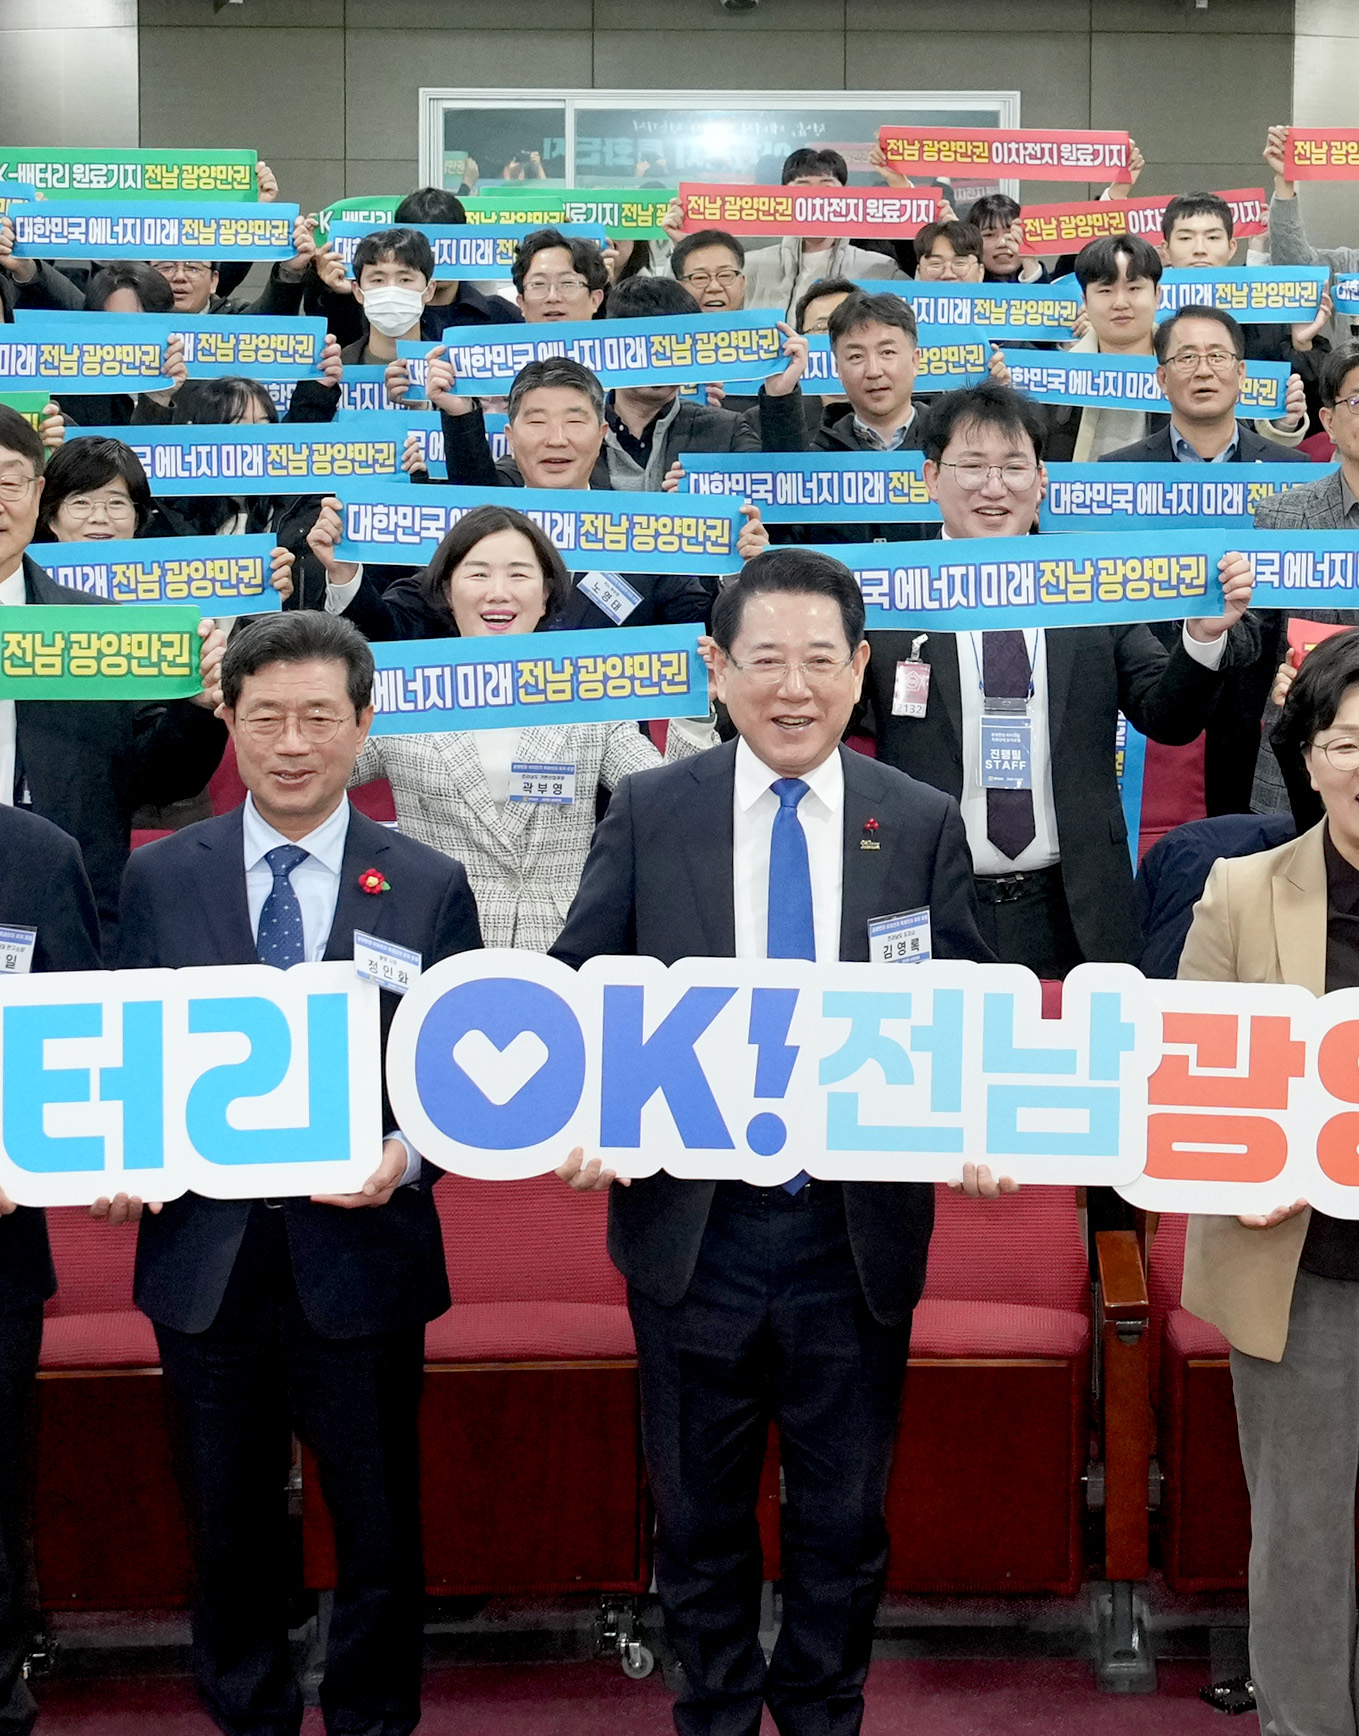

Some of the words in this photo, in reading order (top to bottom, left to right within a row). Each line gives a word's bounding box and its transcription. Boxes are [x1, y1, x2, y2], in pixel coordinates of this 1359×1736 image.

[887, 138, 920, 161] 전남
[922, 139, 990, 164] 광양만권
[991, 142, 1058, 165] 이차전지
[1060, 143, 1128, 168] 원료기지
[1293, 140, 1328, 165] 전남
[72, 163, 142, 190] 원료기지
[144, 163, 179, 190] 전남
[181, 165, 251, 191] 광양만권
[621, 203, 653, 228] 전남
[688, 194, 723, 221] 전남
[724, 194, 793, 222] 광양만권
[795, 198, 864, 223] 이차전지
[15, 216, 87, 245] 대한민국
[219, 218, 289, 246] 광양만권
[1060, 211, 1126, 241] 광양만권
[459, 238, 494, 266] 미래
[1178, 282, 1213, 310] 미래
[1251, 281, 1318, 308] 광양만권
[938, 297, 972, 325] 미래
[81, 345, 161, 377] 광양만권
[237, 333, 316, 364] 광양만권
[604, 336, 648, 370] 미래
[694, 327, 780, 362] 광양만권
[1067, 368, 1122, 398] 에너지
[154, 445, 218, 478] 에너지
[311, 440, 397, 476] 광양만권
[843, 471, 885, 505] 미래
[1050, 481, 1136, 515] 대한민국
[1203, 482, 1244, 516] 미래
[347, 502, 447, 544] 대한민국
[579, 510, 630, 553] 전남
[631, 513, 731, 555] 광양만권
[112, 561, 162, 601] 전남
[165, 556, 264, 599] 광양만권
[894, 563, 977, 612] 에너지
[1039, 558, 1095, 603] 전남
[1097, 554, 1208, 601] 광양만권
[1284, 550, 1354, 589] 에너지
[3, 630, 65, 678] 전남
[70, 631, 190, 678] 광양만권
[372, 666, 452, 715] 에너지
[456, 661, 513, 708] 미래
[516, 656, 574, 705] 전남
[576, 649, 691, 700] 광양만권
[895, 702, 923, 715] 2132
[984, 759, 1027, 771] STAFF
[414, 977, 802, 1157] OK!
[818, 990, 1136, 1157] 전남
